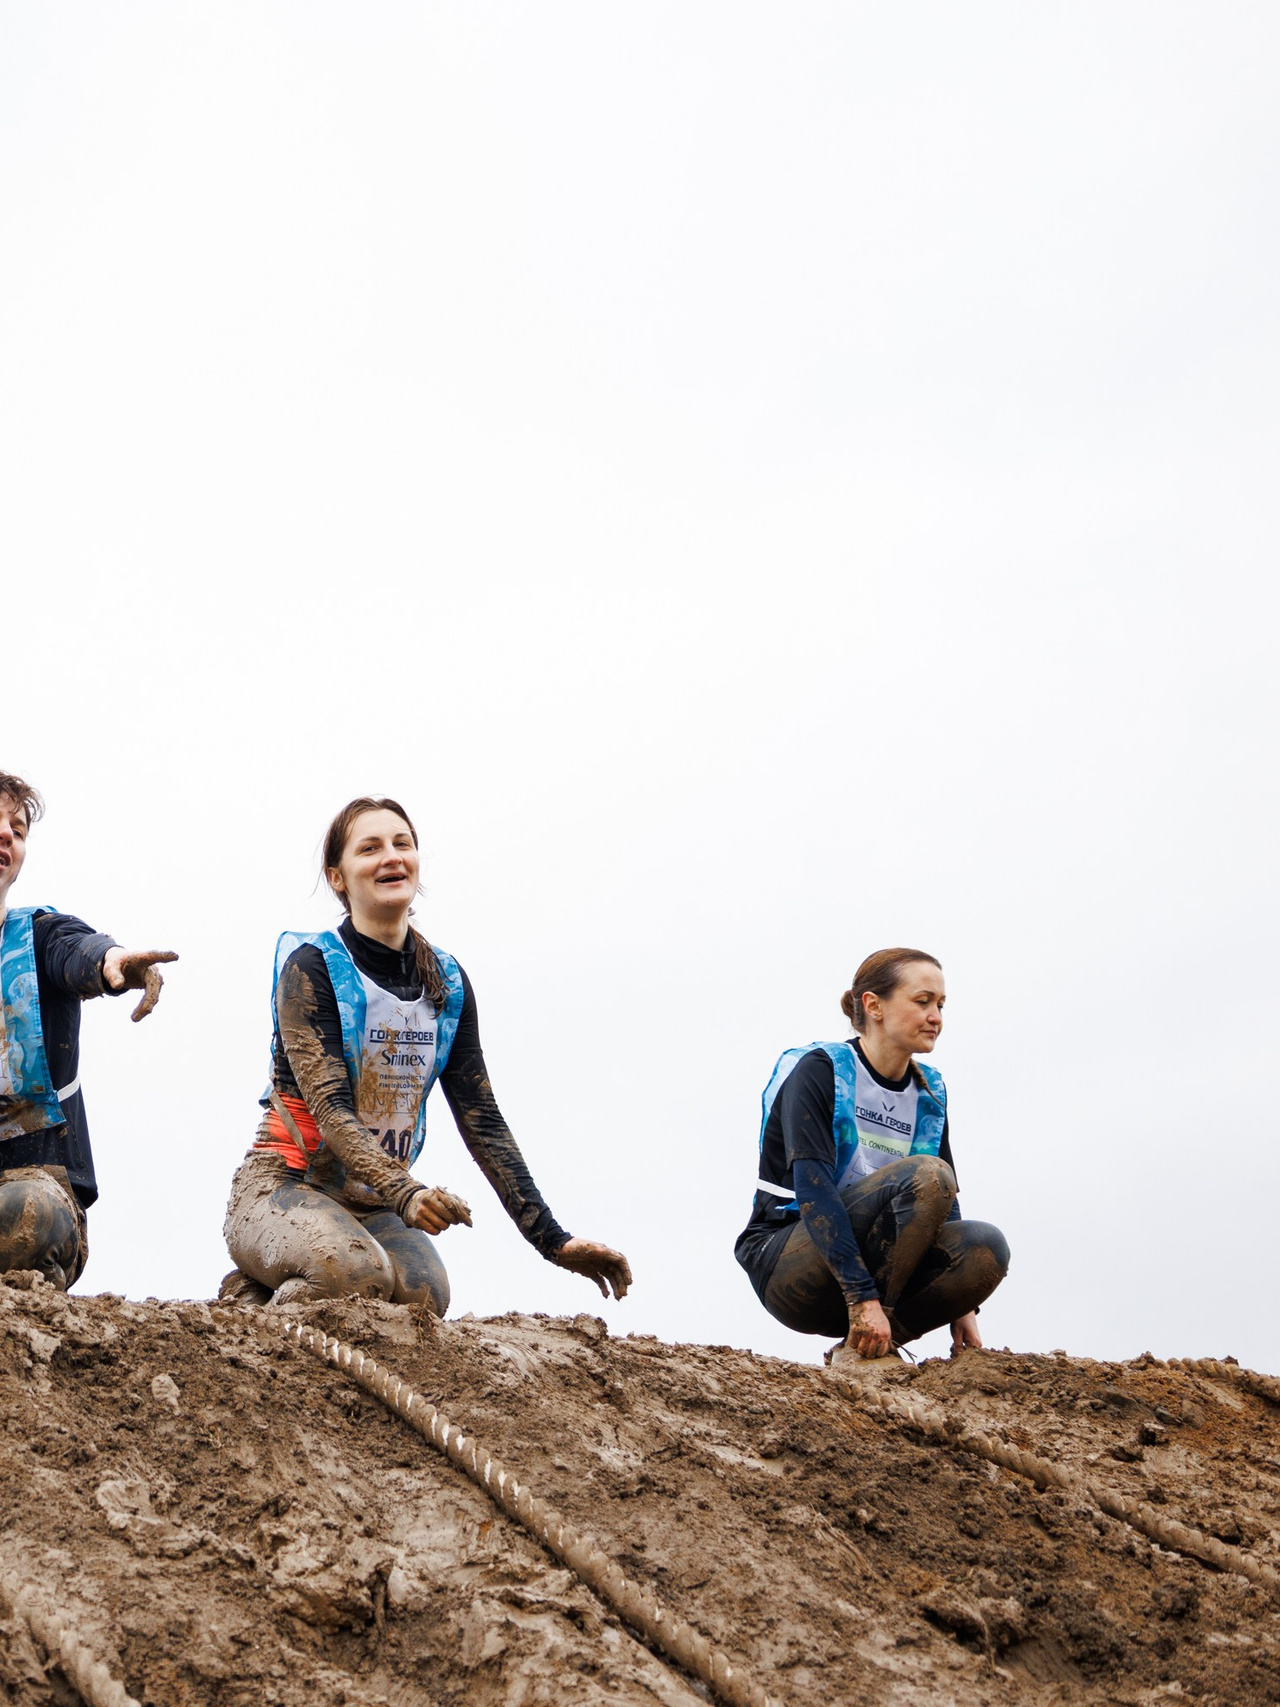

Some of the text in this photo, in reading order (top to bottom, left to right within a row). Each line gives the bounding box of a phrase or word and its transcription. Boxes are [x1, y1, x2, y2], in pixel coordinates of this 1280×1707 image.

[855, 1106, 912, 1132] ГОНКА ГЕРОЕВ
[868, 1140, 905, 1159] CONTINENTAL
